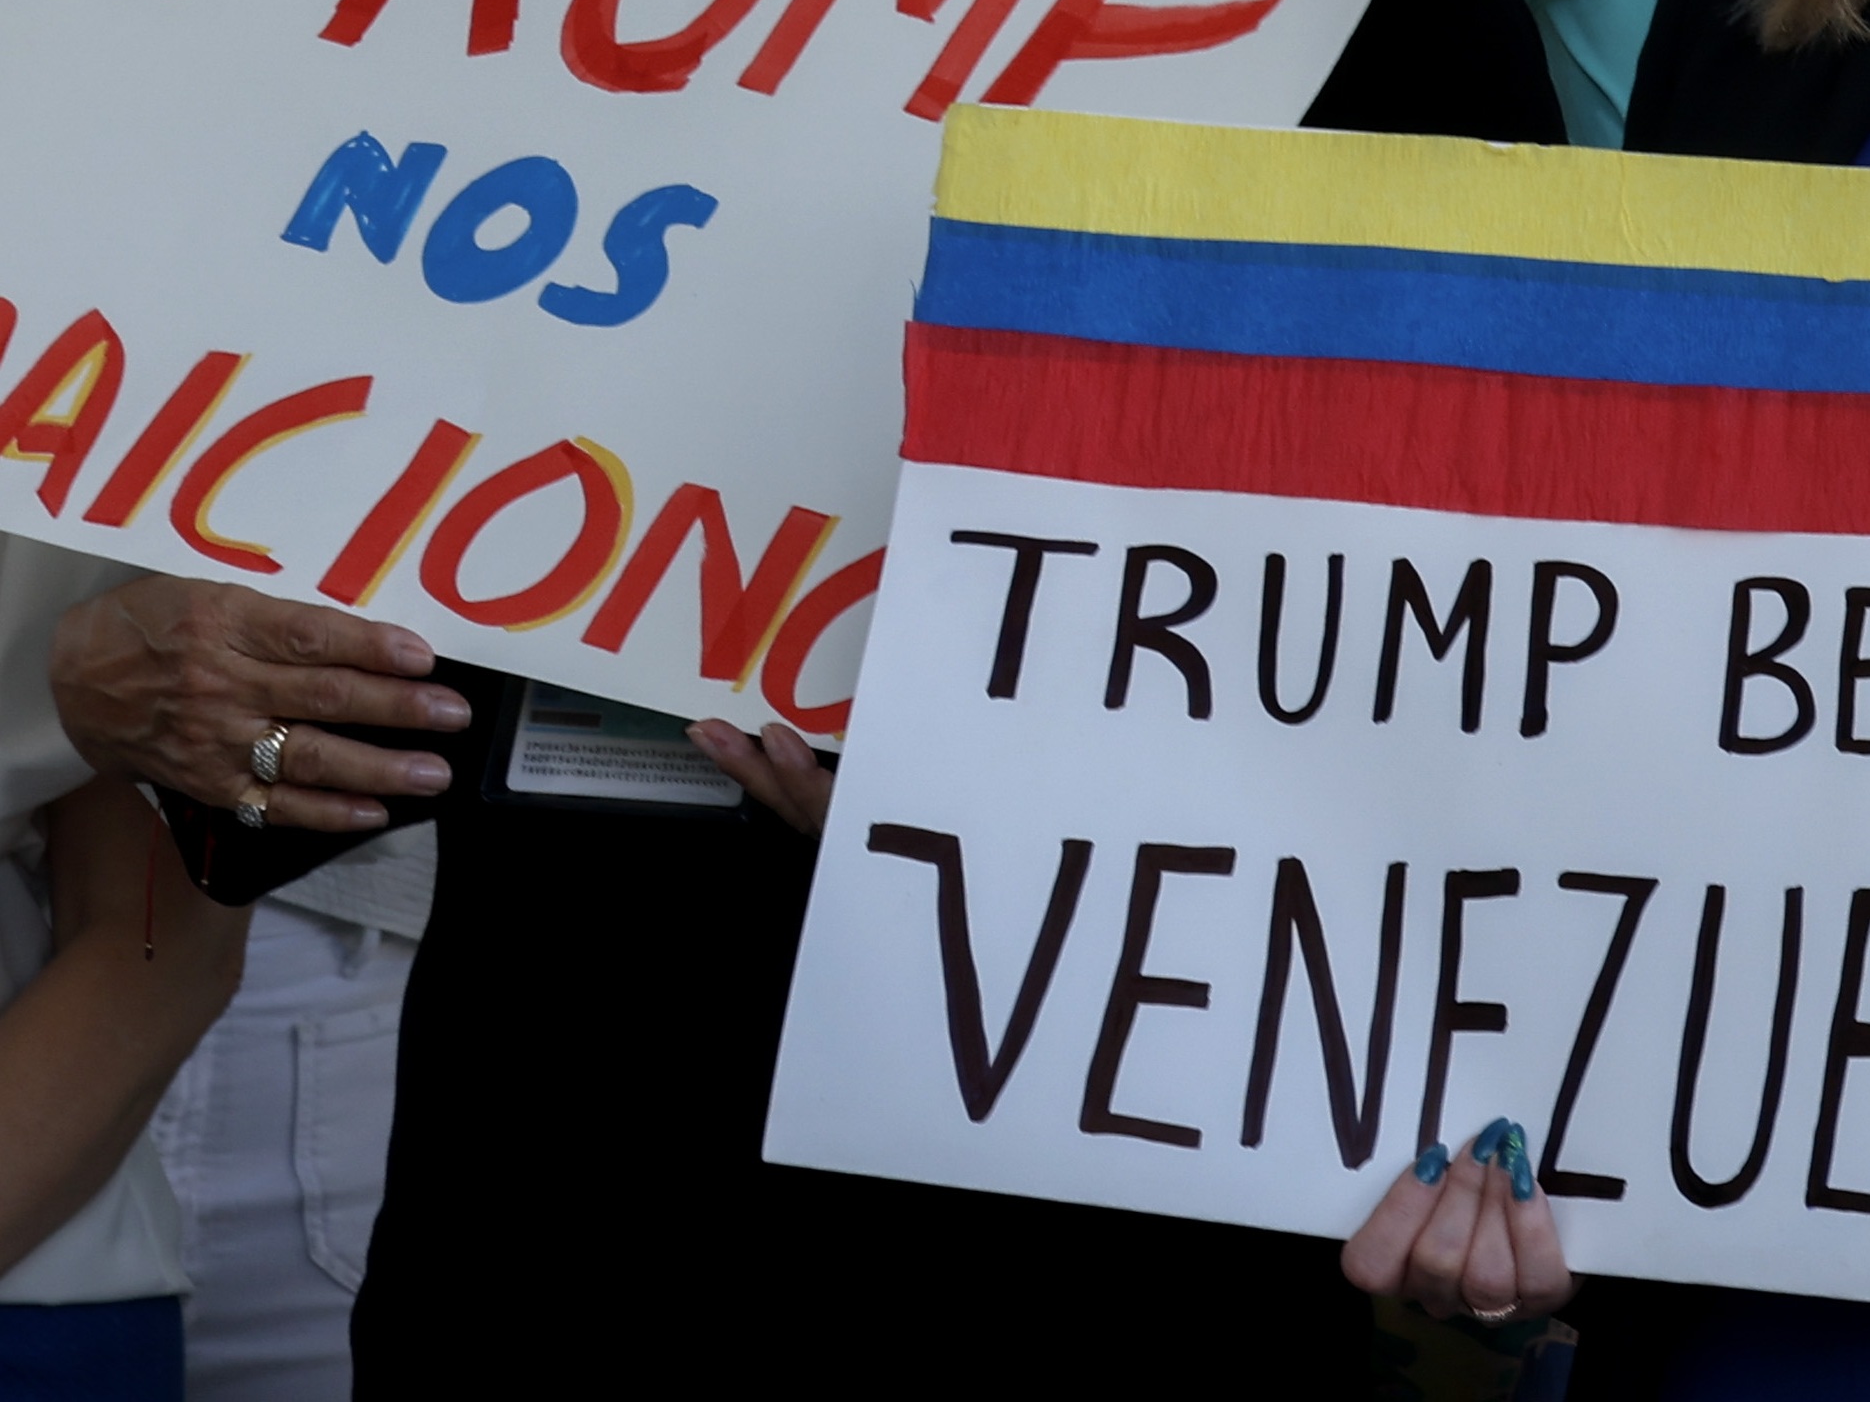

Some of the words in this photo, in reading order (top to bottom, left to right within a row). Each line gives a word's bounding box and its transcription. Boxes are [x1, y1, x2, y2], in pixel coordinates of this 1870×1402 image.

[280, 131, 718, 327] NOS
[0, 298, 887, 740] AICIONO
[950, 531, 1618, 737] TRUMP
